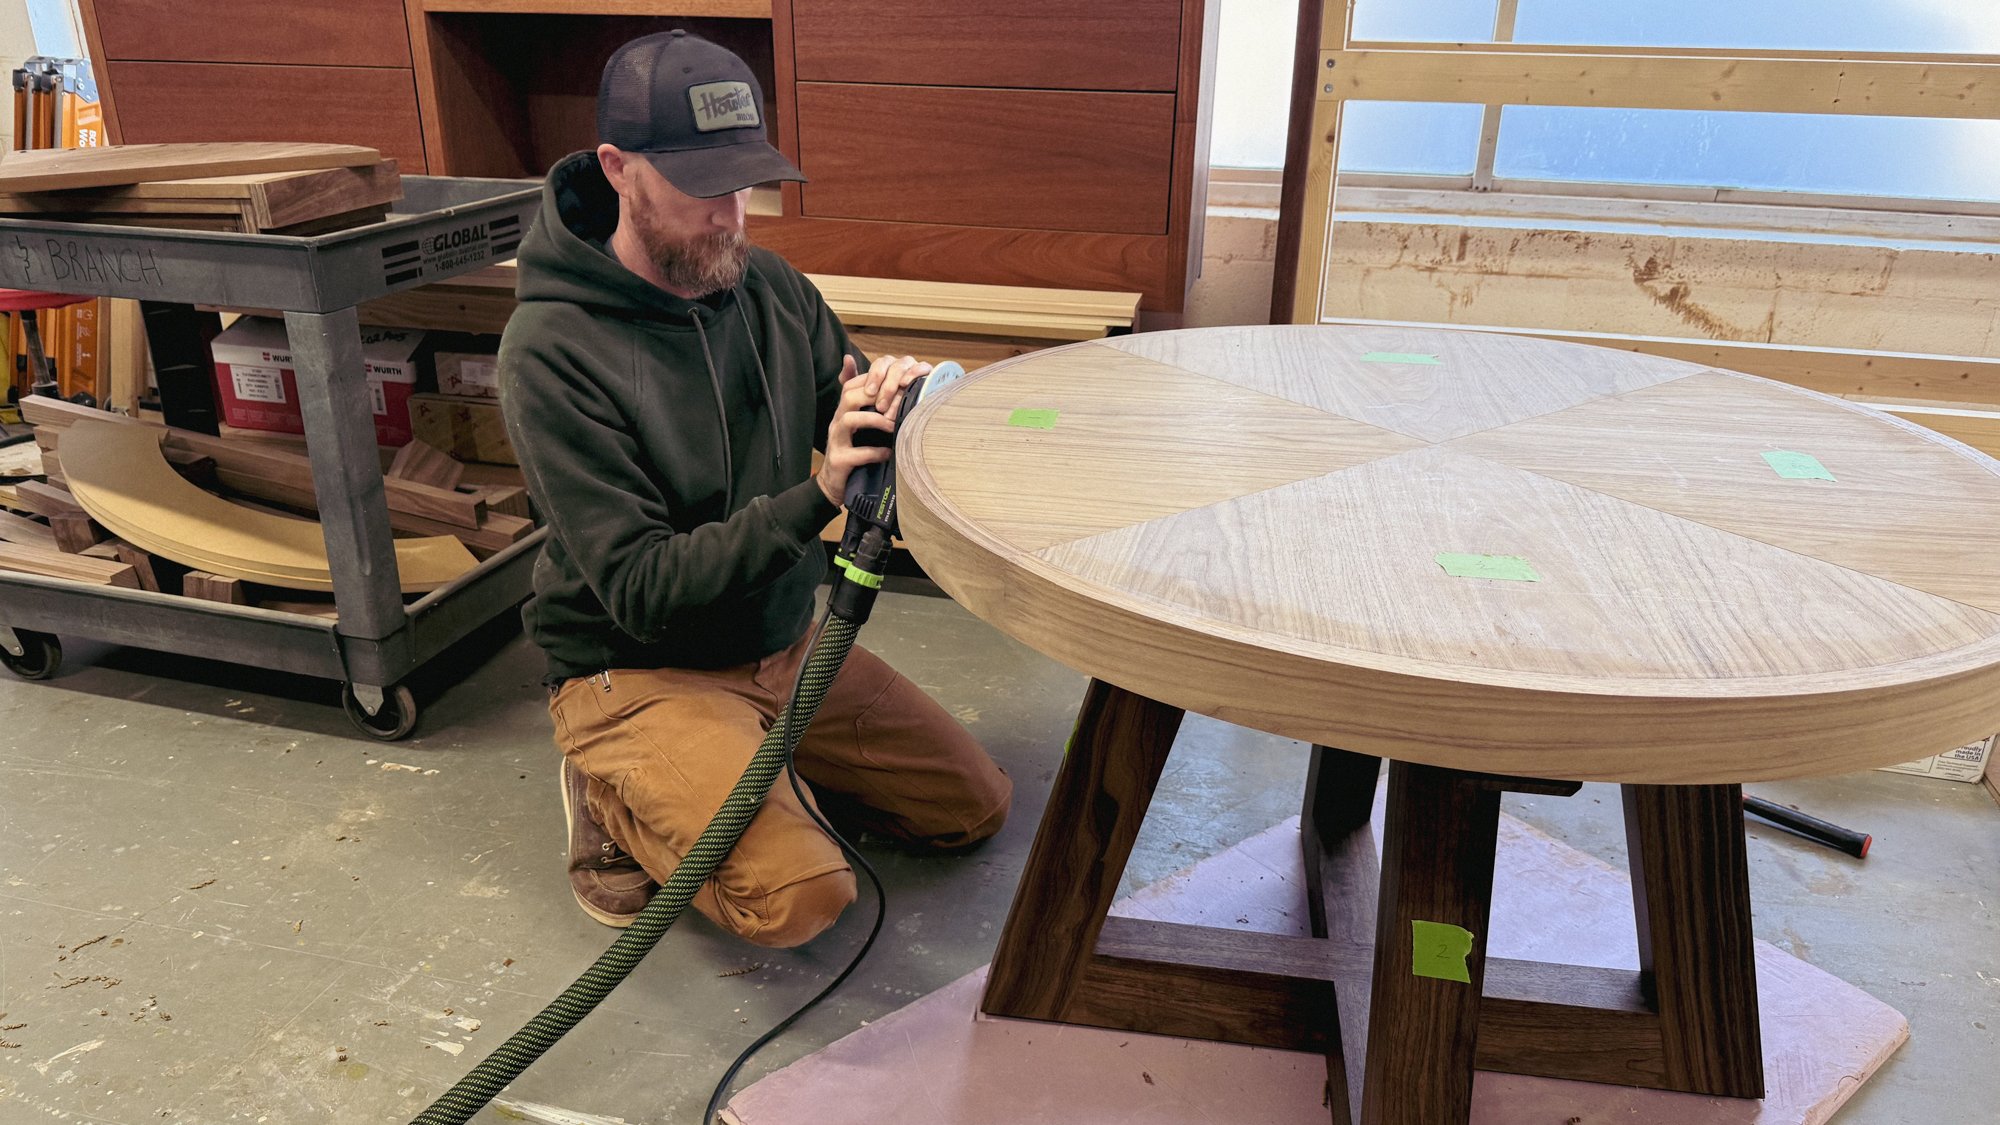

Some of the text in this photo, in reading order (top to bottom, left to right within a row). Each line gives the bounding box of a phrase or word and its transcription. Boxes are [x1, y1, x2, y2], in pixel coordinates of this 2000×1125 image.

[433, 223, 489, 253] GLOBAL
[46, 238, 163, 286] BRANCH
[877, 485, 891, 519] FESTOOL
[1436, 943, 1450, 960] 2
